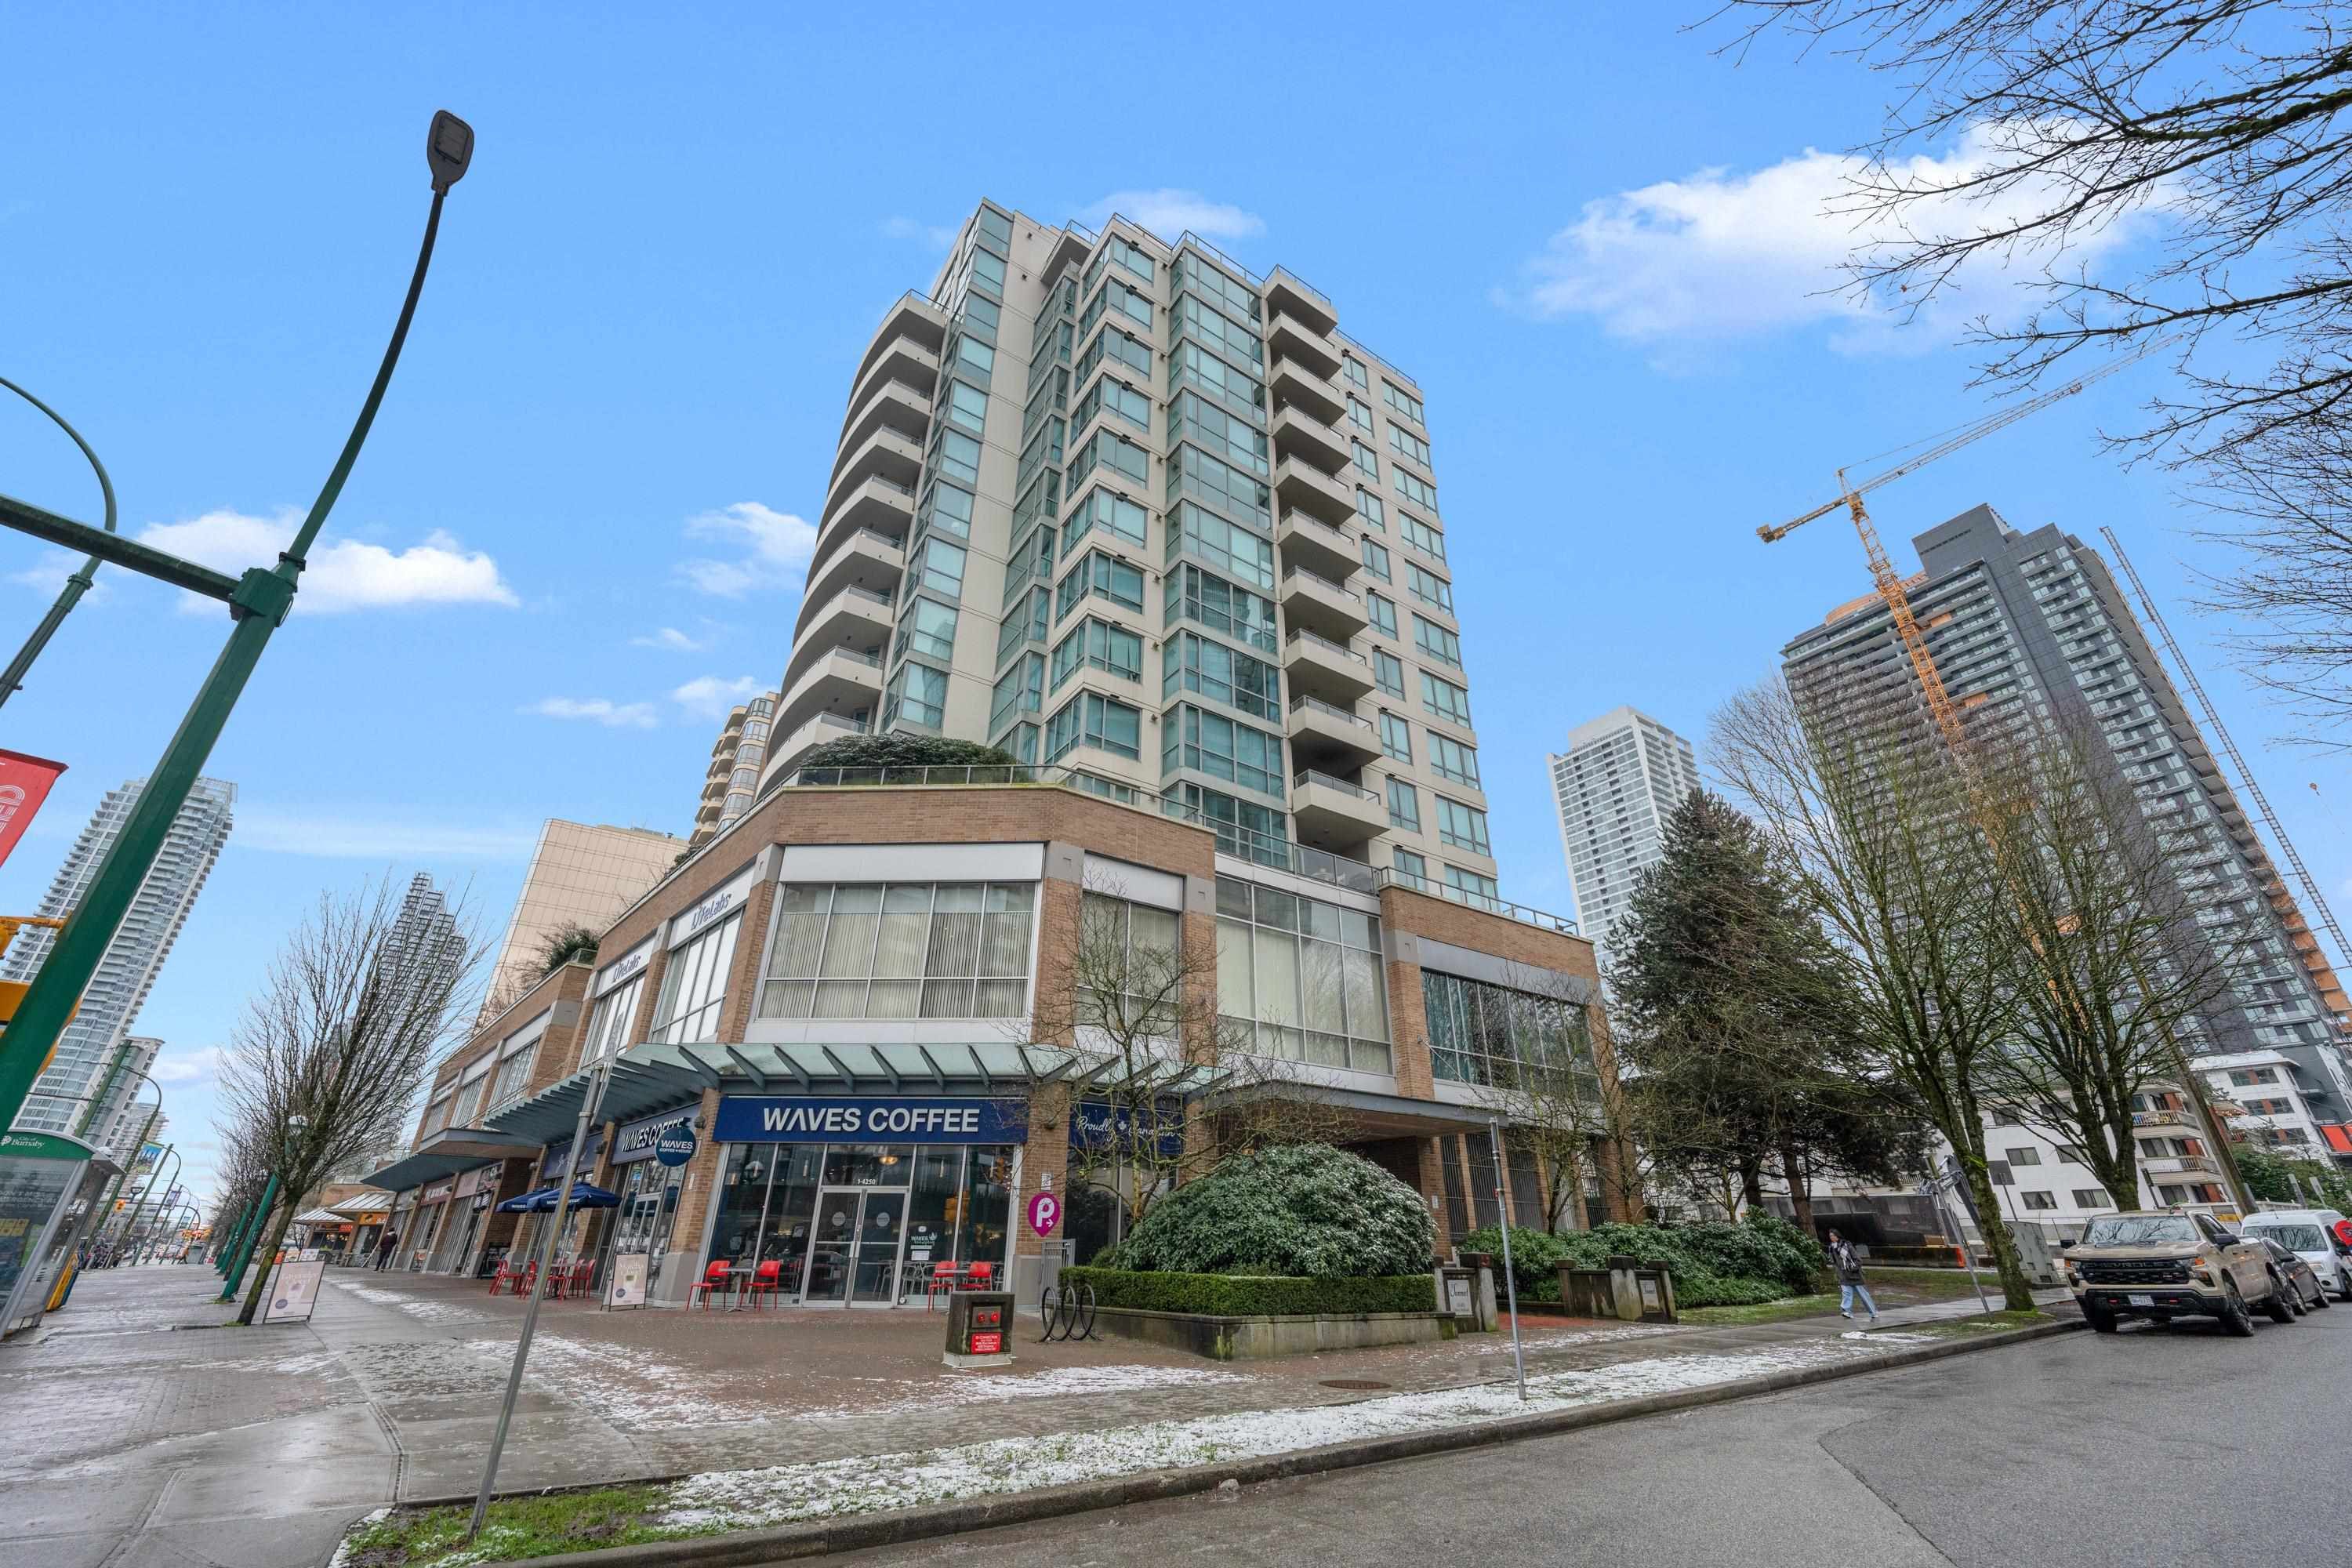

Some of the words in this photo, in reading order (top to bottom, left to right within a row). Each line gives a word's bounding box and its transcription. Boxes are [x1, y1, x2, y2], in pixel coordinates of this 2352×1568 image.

[691, 893, 731, 931] LifeLabs
[764, 1108, 861, 1131] WAVES
[868, 1108, 980, 1132] COFFEE
[11, 1139, 45, 1149] Burnaby
[622, 1127, 650, 1152] WAVES
[661, 1140, 694, 1149] WAVES
[1036, 1197, 1054, 1227] P
